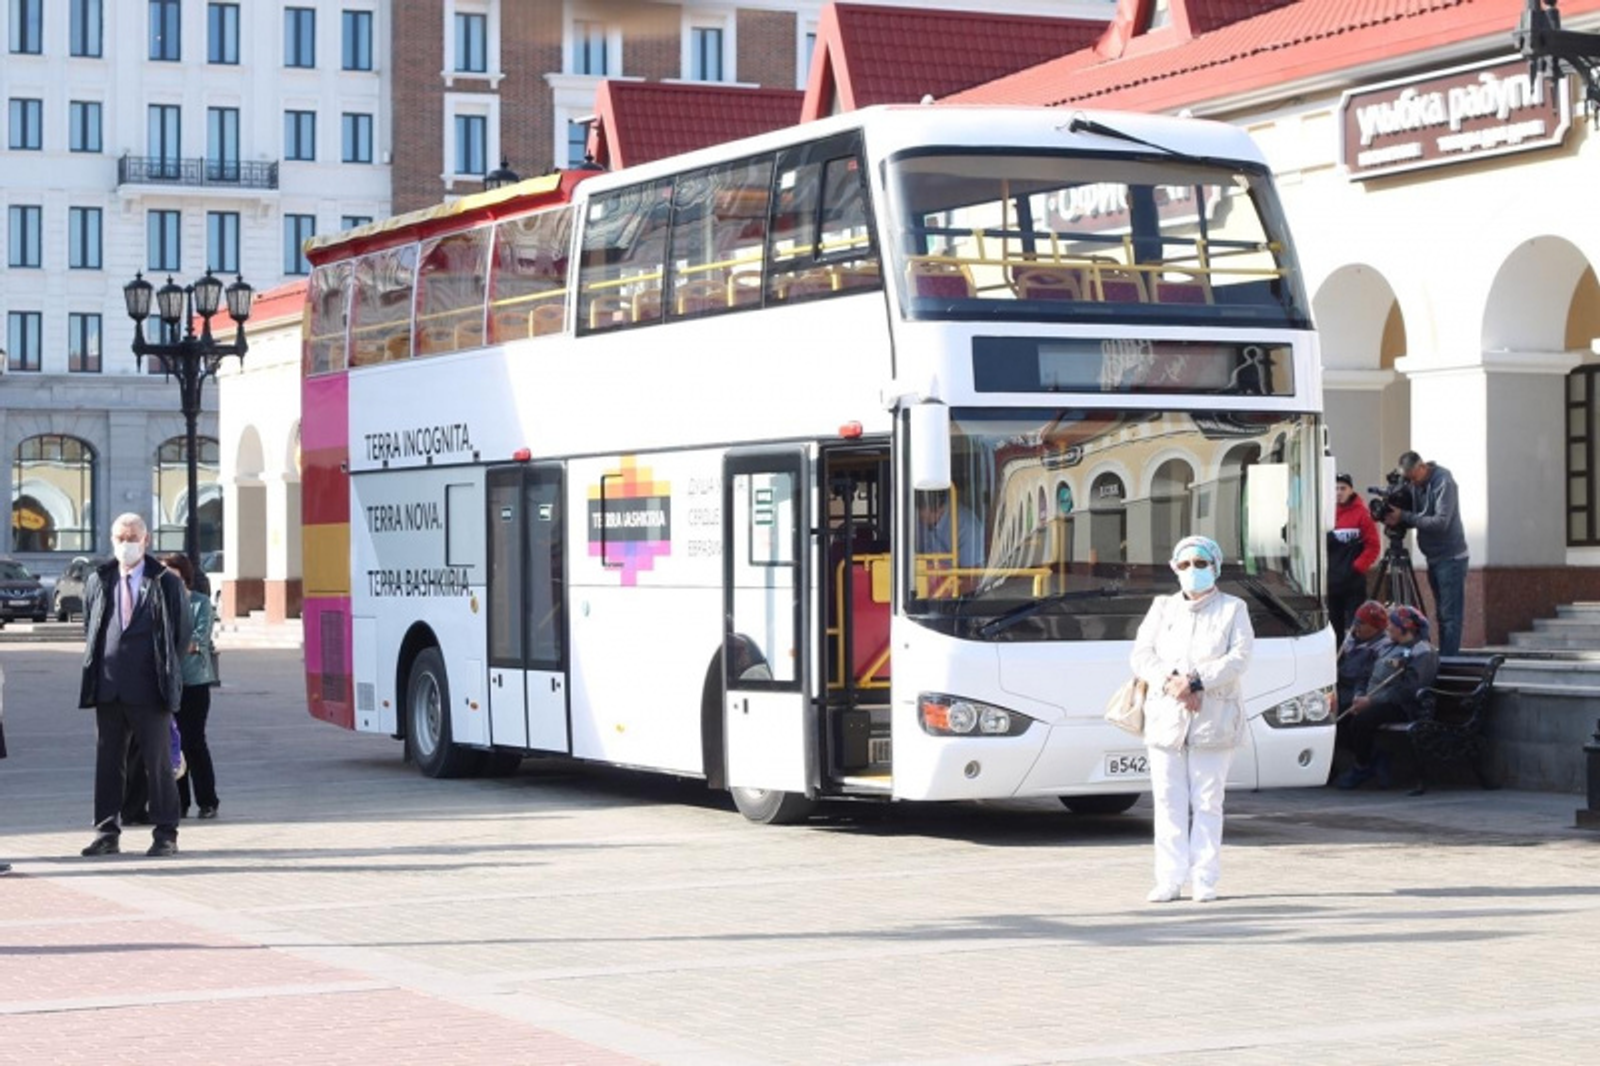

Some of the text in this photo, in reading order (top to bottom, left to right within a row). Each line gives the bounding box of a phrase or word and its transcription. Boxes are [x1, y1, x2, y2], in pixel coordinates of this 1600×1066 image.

[364, 423, 474, 461] TERRA INCOGNITA.
[366, 502, 443, 533] TERRA NOVA.
[367, 568, 474, 597] TERRA BASHKIRIA.
